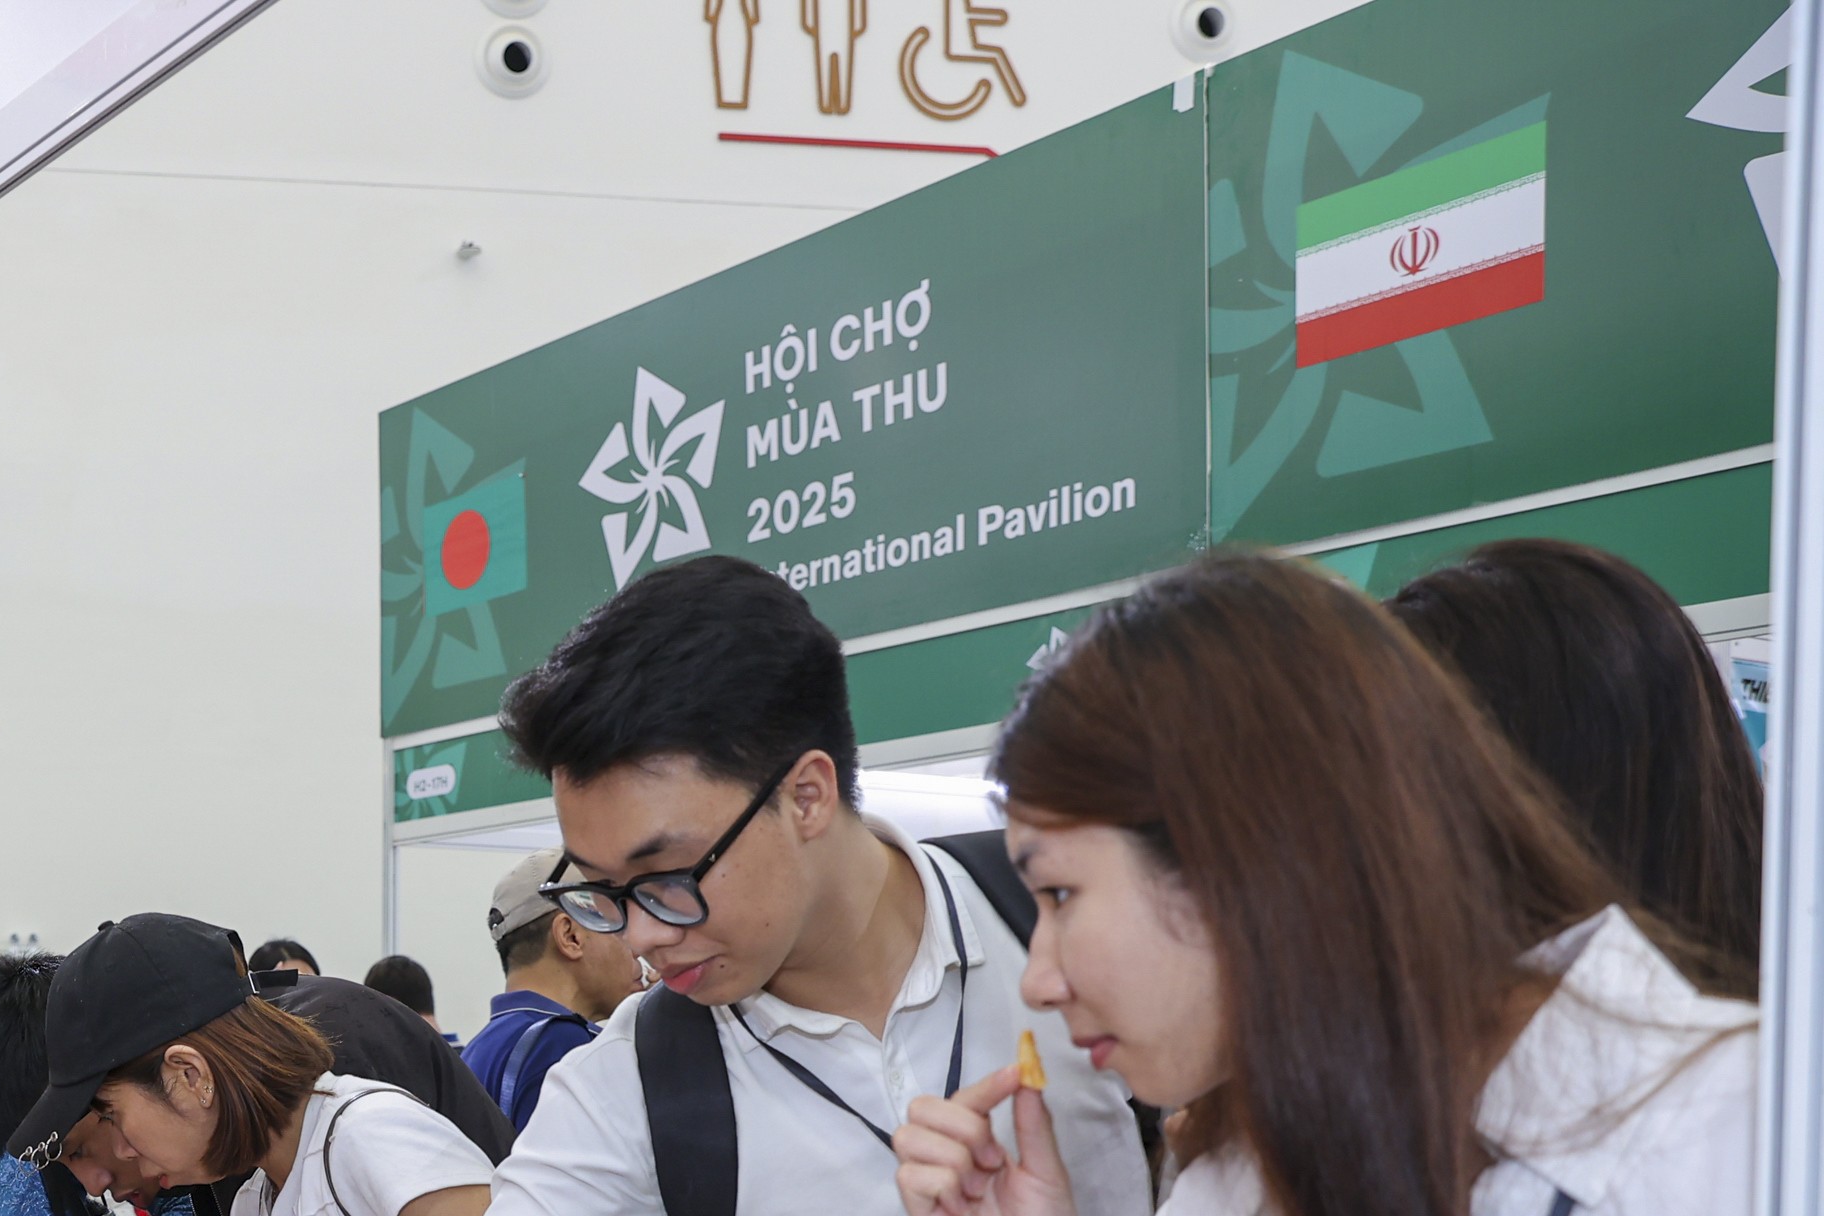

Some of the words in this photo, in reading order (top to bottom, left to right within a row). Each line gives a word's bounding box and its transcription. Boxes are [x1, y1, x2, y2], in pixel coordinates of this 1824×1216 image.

[744, 324, 819, 394] HỘI
[830, 279, 933, 364] CHỢ
[745, 400, 842, 469] MÙA
[853, 362, 949, 432] THU
[746, 471, 857, 544] 2025
[978, 477, 1136, 547] Pavilion
